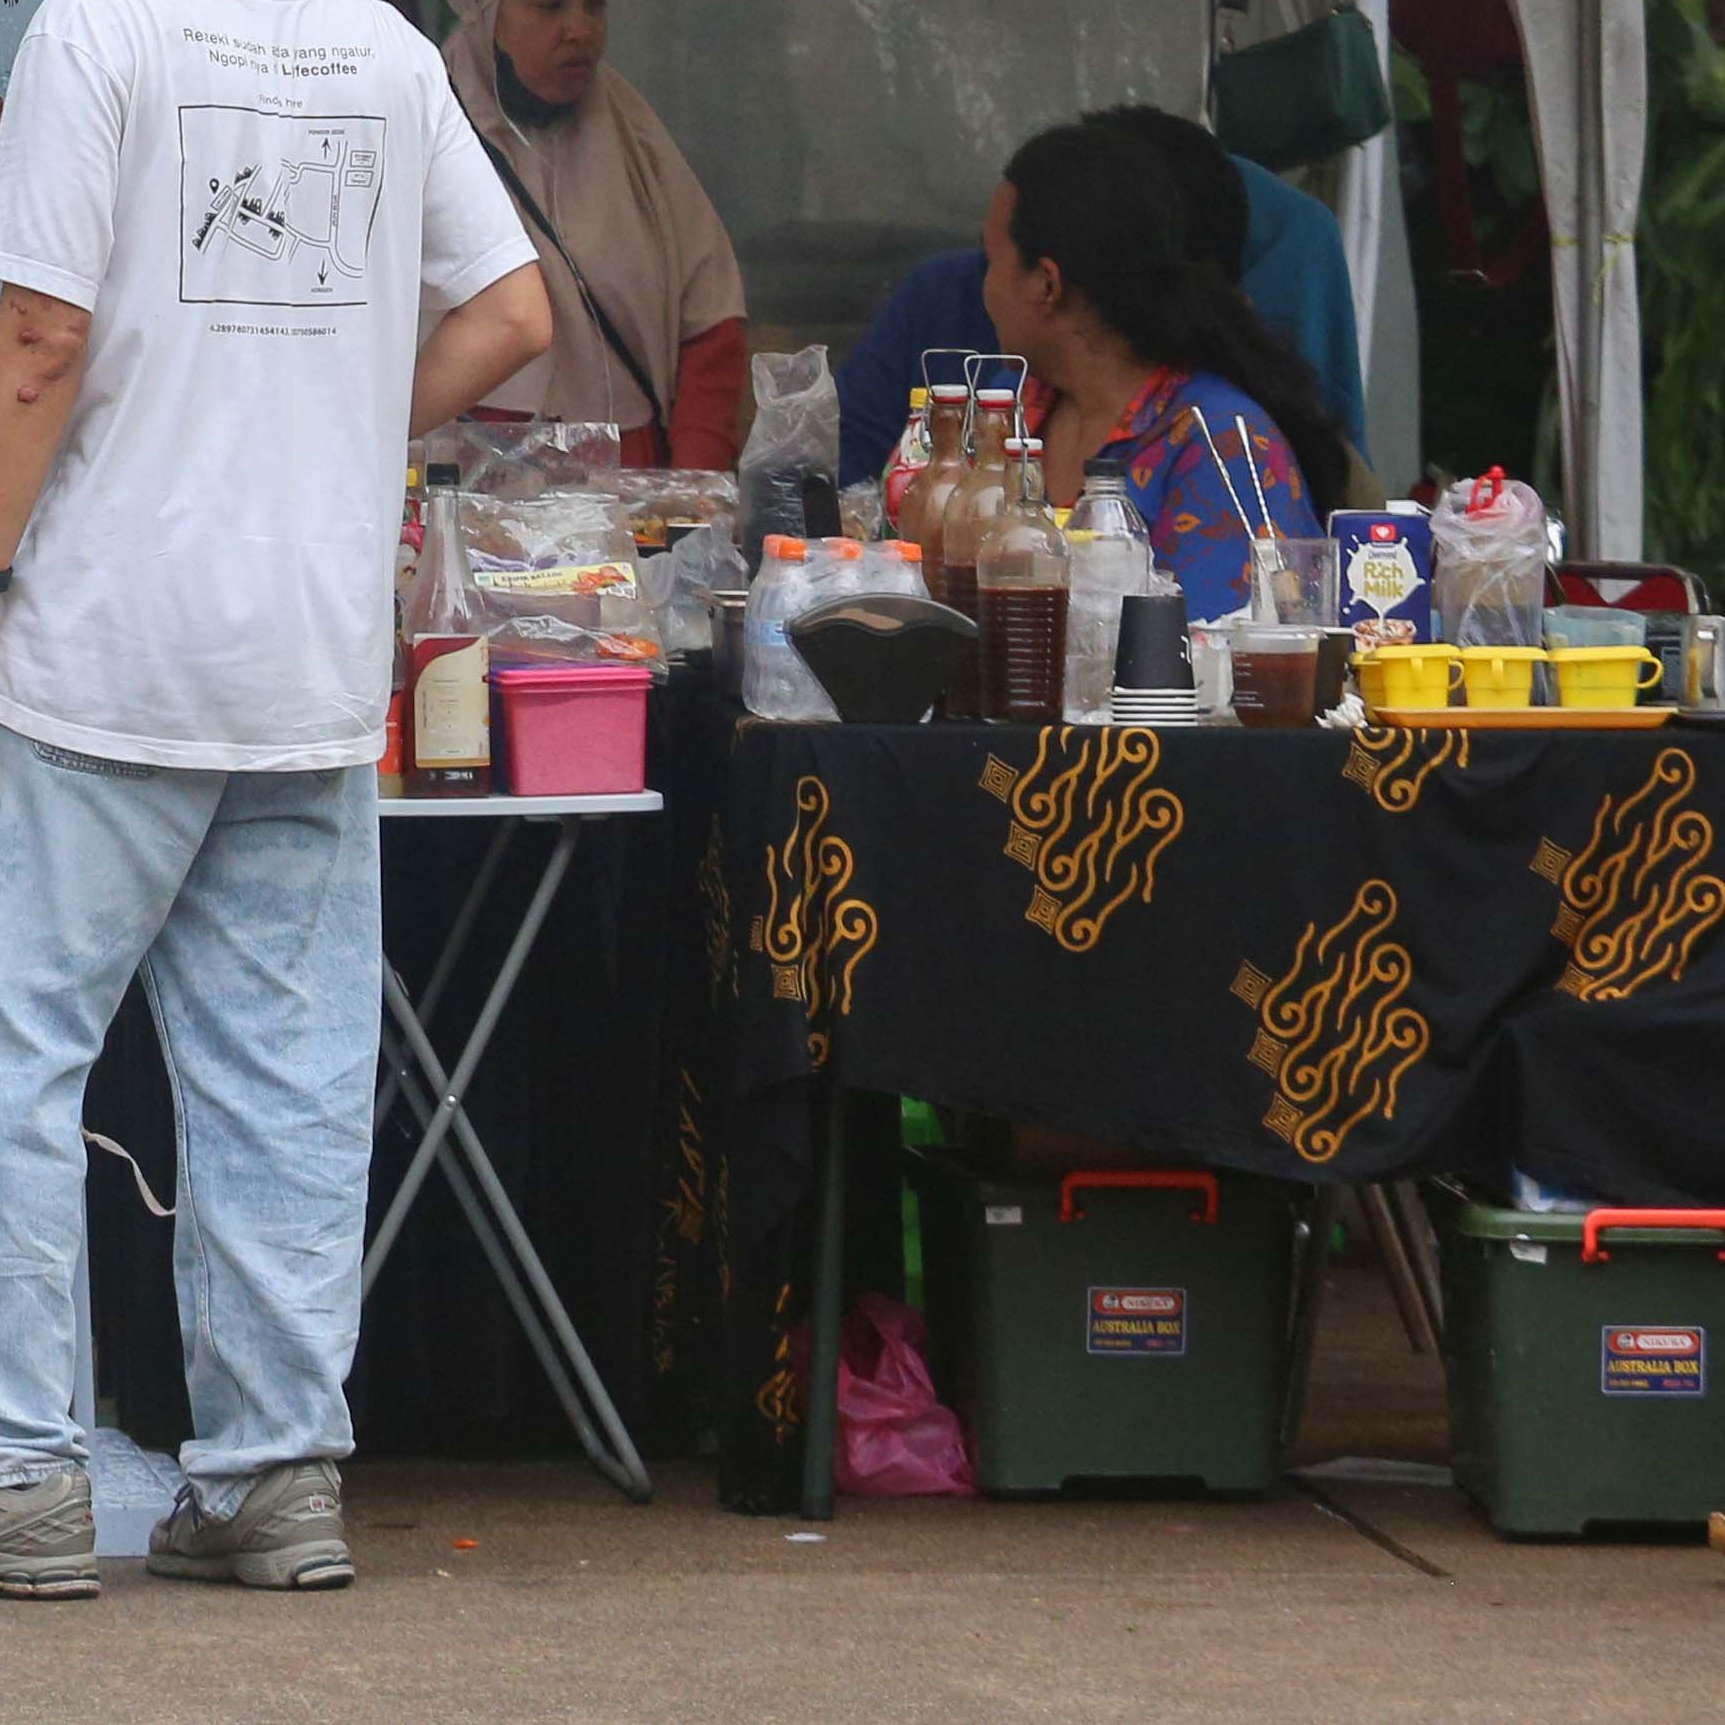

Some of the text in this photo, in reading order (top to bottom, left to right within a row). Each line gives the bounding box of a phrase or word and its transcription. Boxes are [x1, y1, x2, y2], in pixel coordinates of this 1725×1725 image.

[1364, 561, 1403, 578] Rich
[1364, 579, 1404, 597] Milk
[1092, 1320, 1181, 1335] AUSTRALIA BOX
[1608, 1359, 1700, 1374] AUSTRALIA BOX
